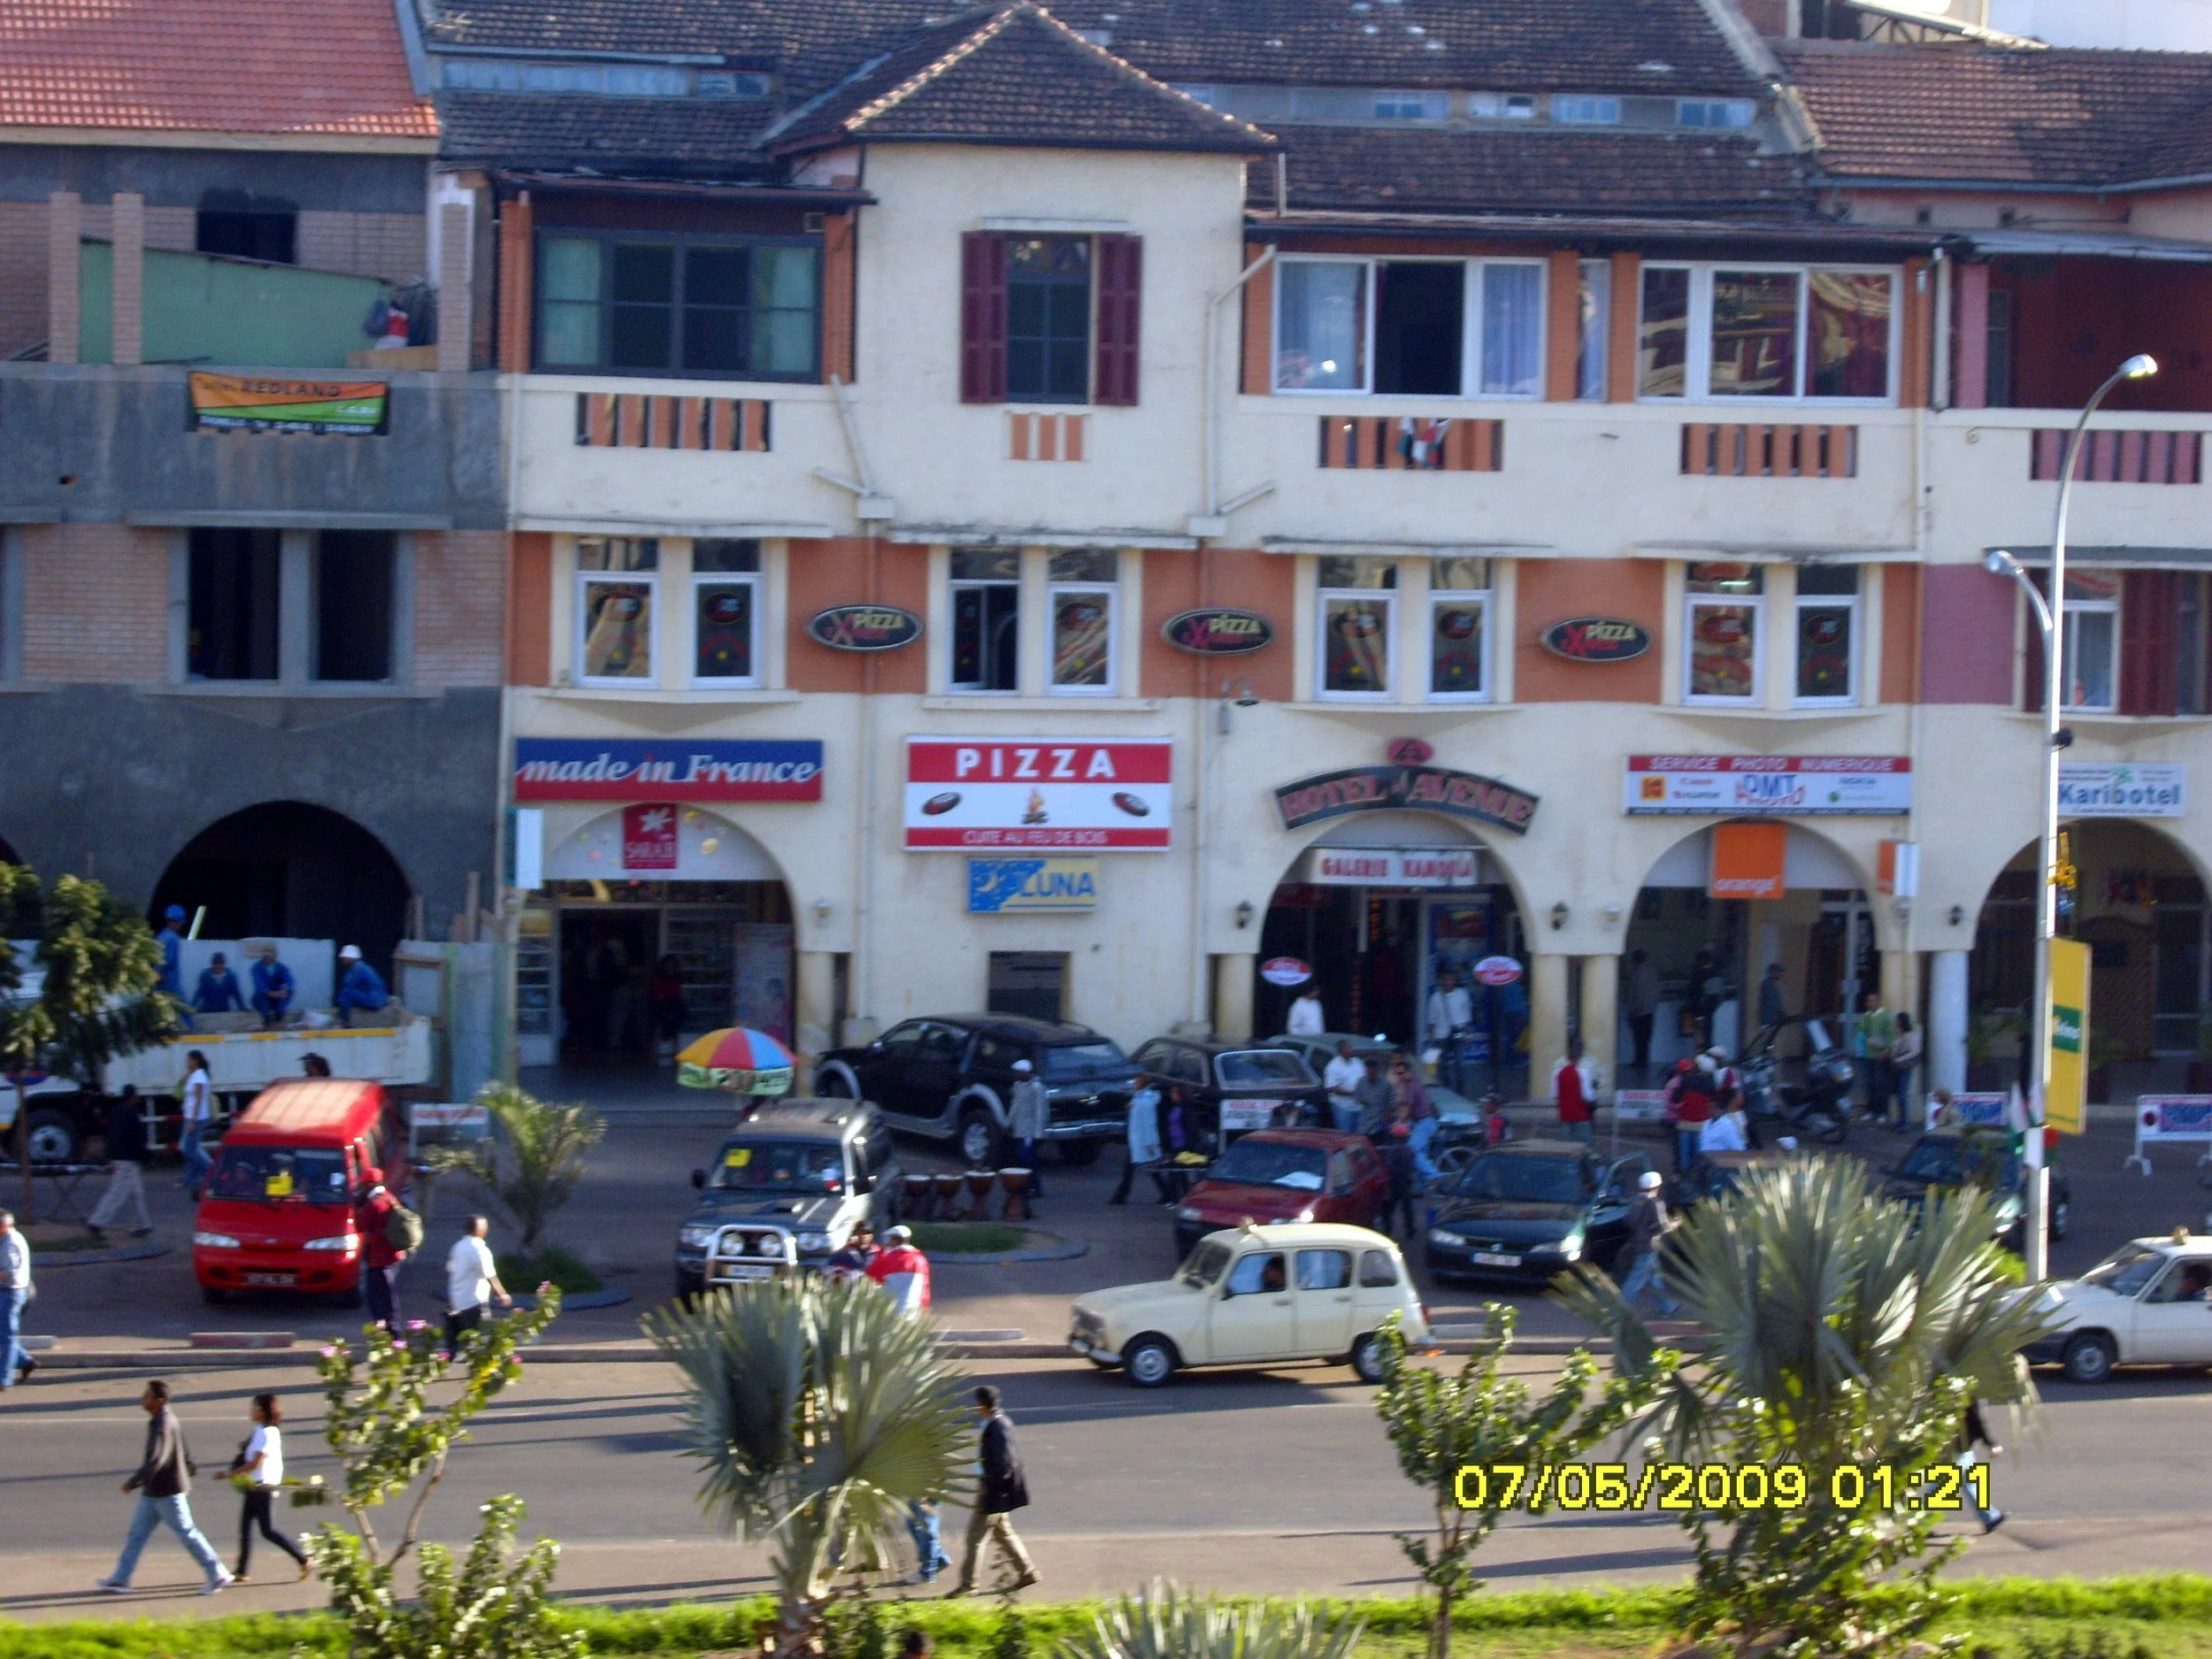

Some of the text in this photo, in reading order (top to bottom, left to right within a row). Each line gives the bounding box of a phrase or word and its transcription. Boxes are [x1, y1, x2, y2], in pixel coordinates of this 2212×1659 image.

[516, 752, 819, 783] made in France
[956, 748, 1117, 779] PIZZA
[1648, 757, 1720, 771] SERVICE
[1729, 757, 1788, 772] PHOTO
[1281, 774, 1387, 821] HOTEL
[1405, 773, 1536, 826] AVENUE
[2059, 782, 2182, 805] Karibotel
[1321, 857, 1388, 878] GALERIE
[1018, 871, 1096, 897] LUNA
[1714, 877, 1775, 895] orange
